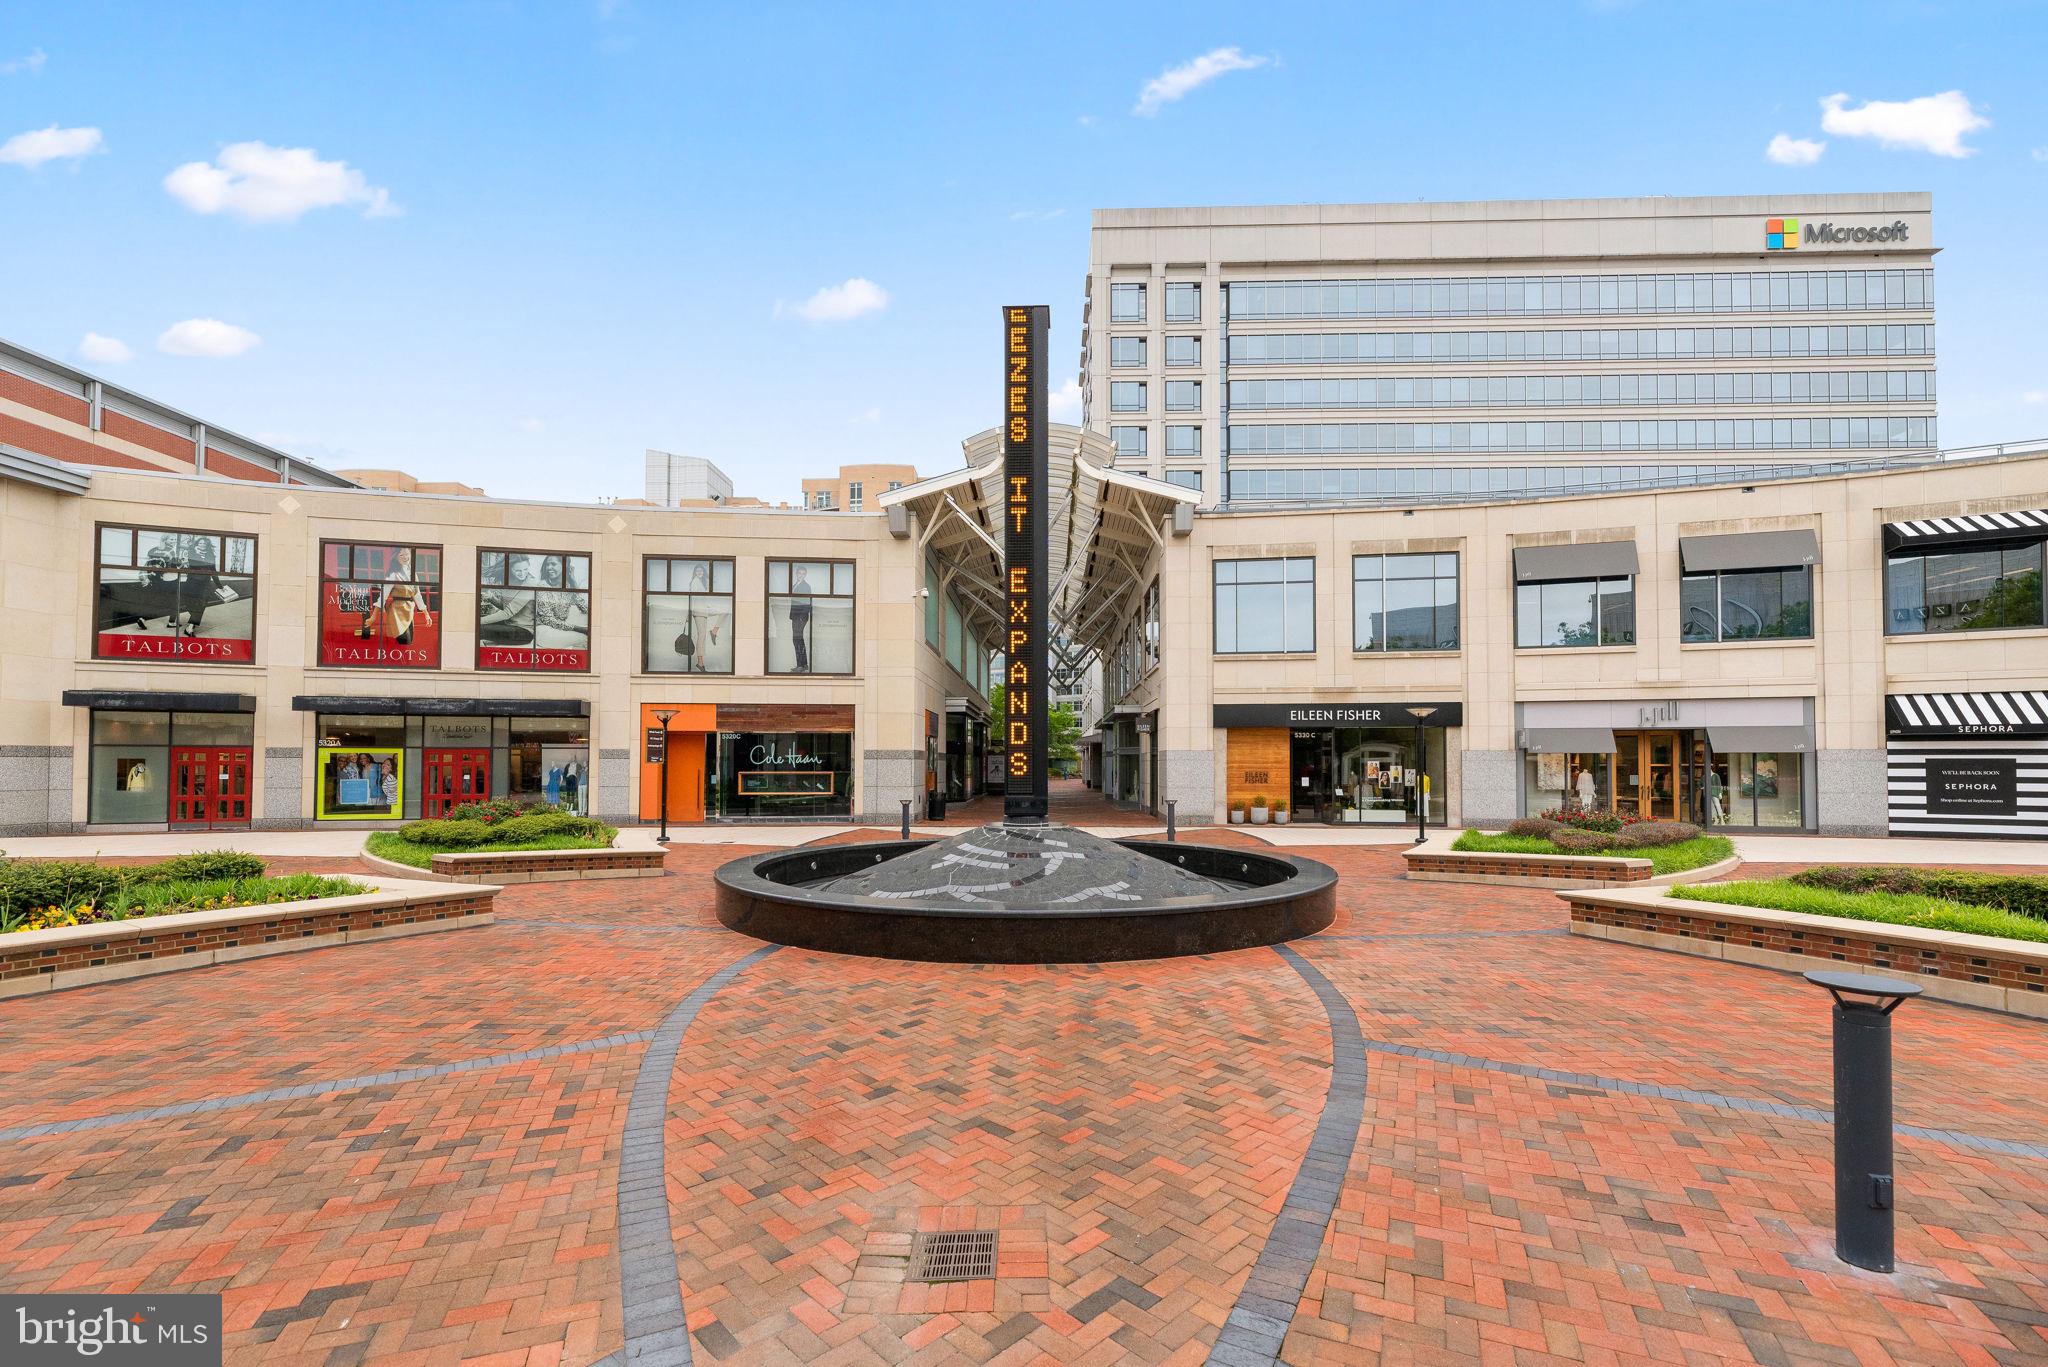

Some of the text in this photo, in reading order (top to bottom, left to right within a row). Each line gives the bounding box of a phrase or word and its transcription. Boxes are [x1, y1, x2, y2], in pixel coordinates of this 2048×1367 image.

[1804, 220, 1909, 244] Microsoft
[1010, 476, 1027, 533] IT
[121, 640, 232, 656] TALBOTS
[335, 647, 427, 661] TALBOTS
[491, 652, 578, 665] TALBOTS
[1010, 567, 1028, 776] EXPANDS
[1290, 709, 1382, 721] EILEEN FISHER
[429, 725, 487, 734] TALBOTS
[1958, 725, 2014, 733] SEPHORA
[318, 739, 342, 747] 5320A
[749, 740, 823, 768] Cole Haan
